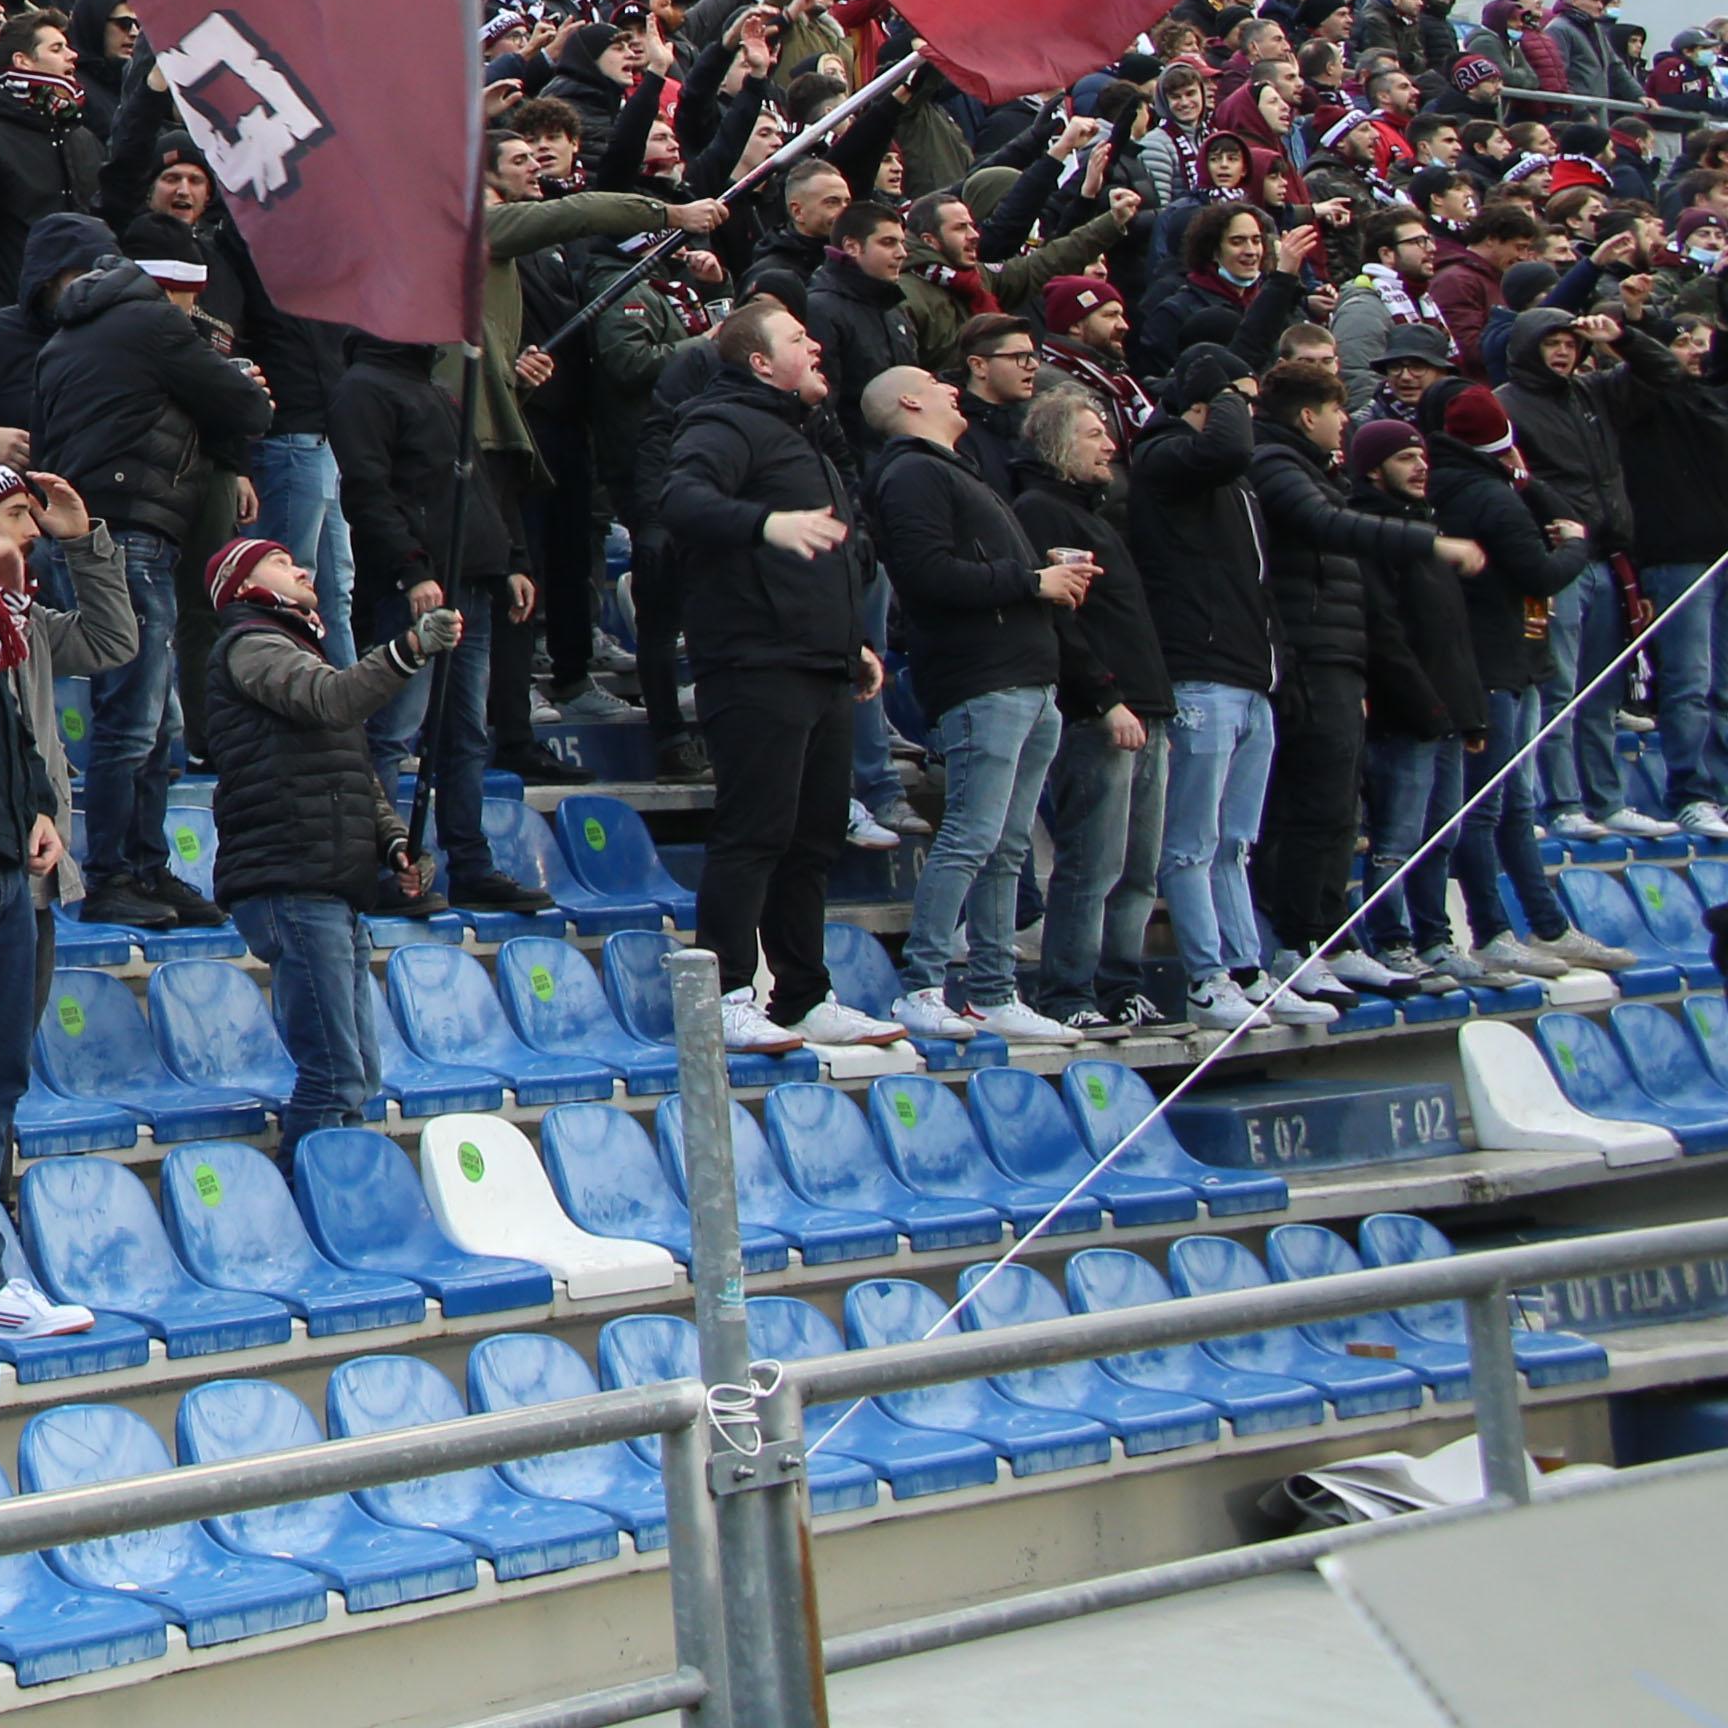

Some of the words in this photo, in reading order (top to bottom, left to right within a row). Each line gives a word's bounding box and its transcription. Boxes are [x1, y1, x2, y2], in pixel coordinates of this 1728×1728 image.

[1247, 1118, 1266, 1164] E
[1273, 1113, 1309, 1161] 02
[1388, 1103, 1409, 1146] F
[1414, 1095, 1449, 1143] 02
